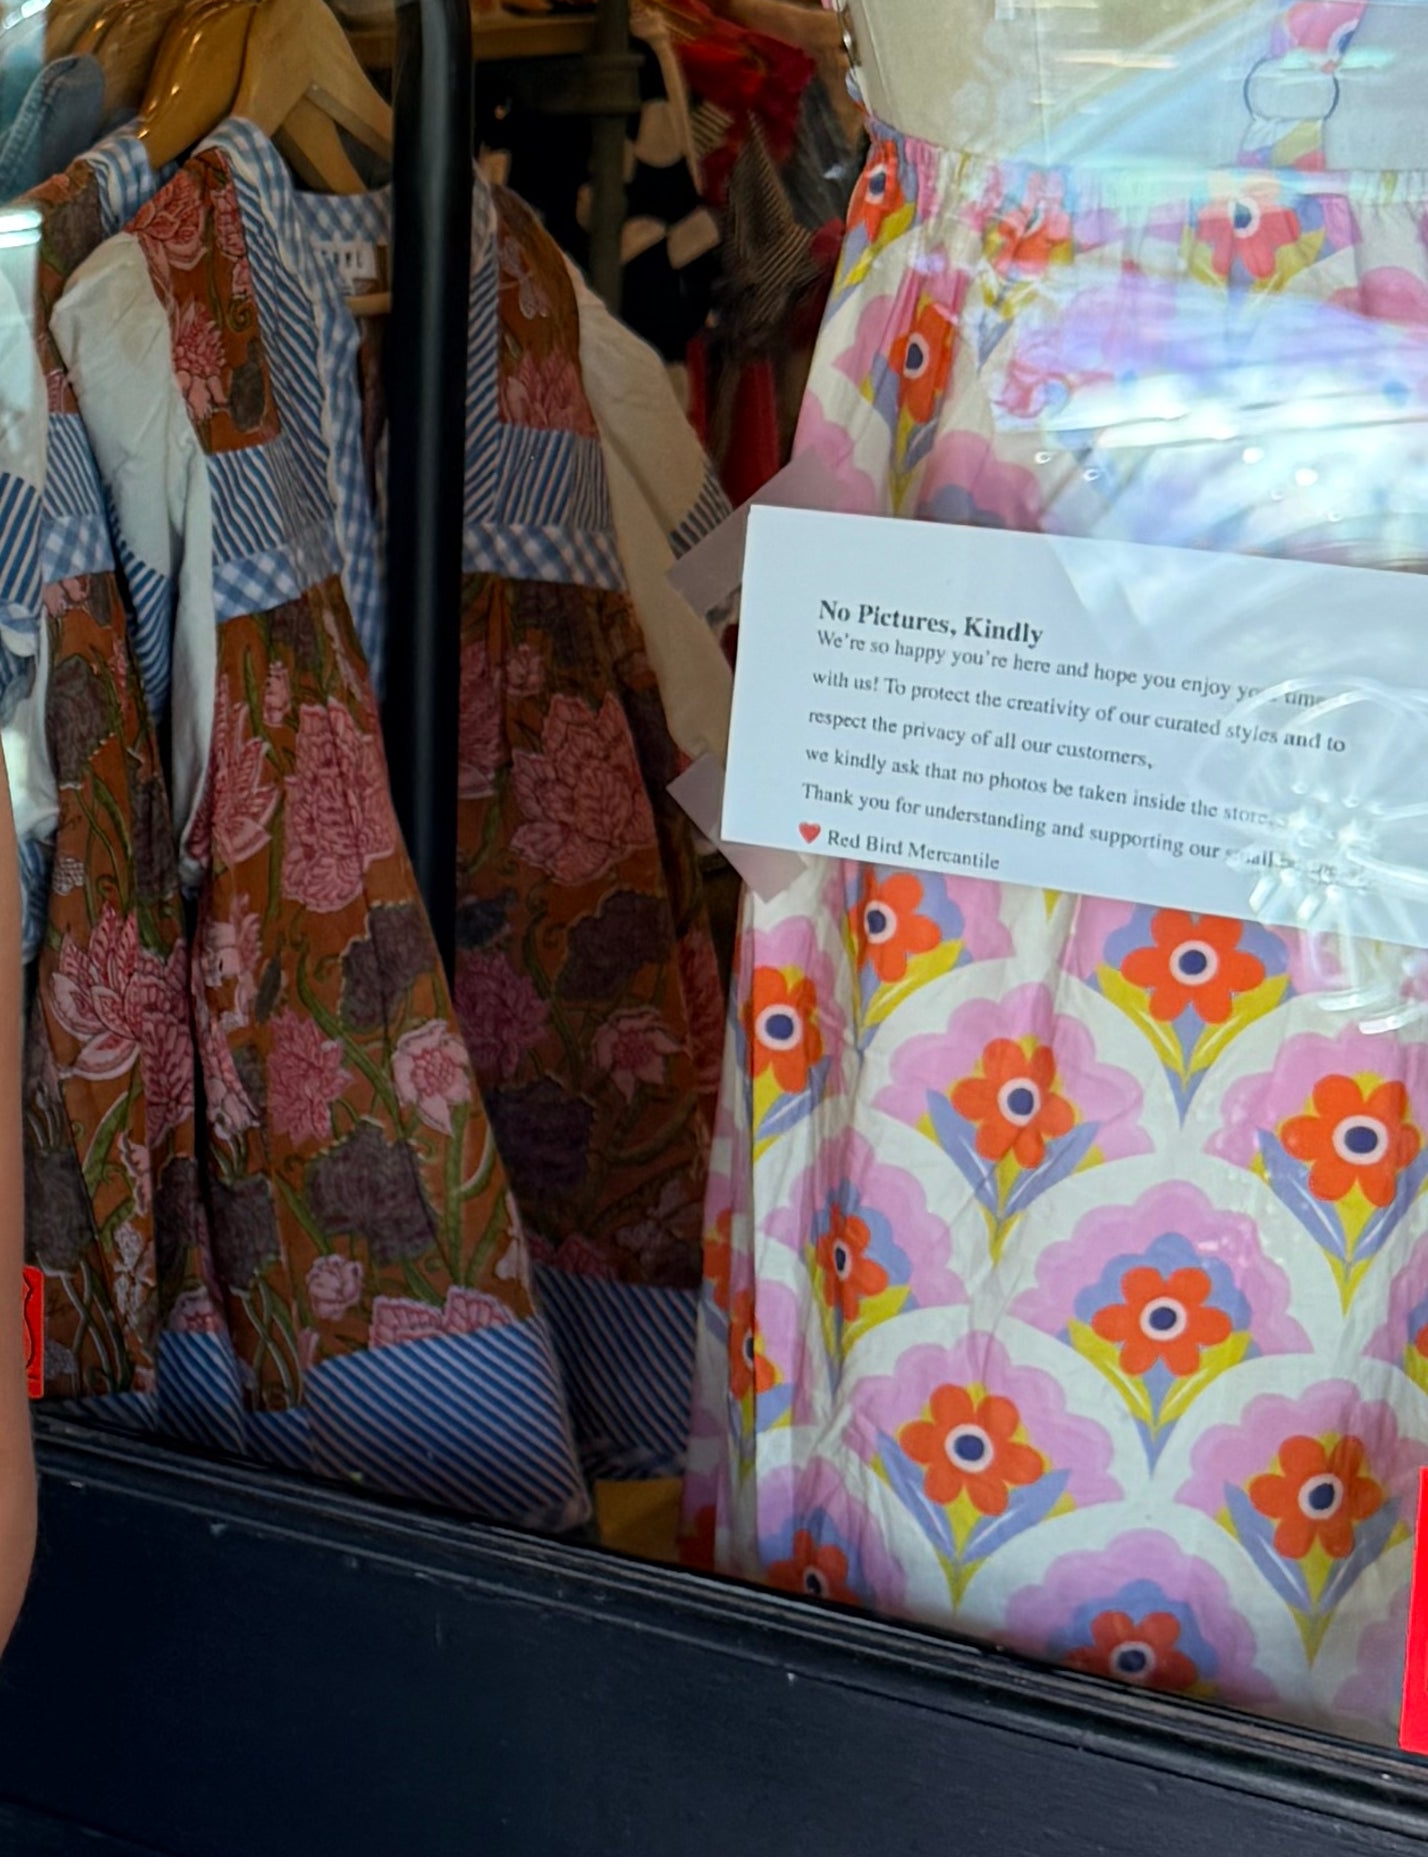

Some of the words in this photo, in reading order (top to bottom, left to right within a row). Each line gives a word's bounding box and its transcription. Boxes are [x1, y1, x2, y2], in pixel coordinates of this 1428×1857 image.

[819, 599, 851, 623] No
[858, 603, 958, 638] Pictures,
[963, 616, 1044, 649] Kindly
[817, 630, 866, 651] We're
[869, 641, 890, 654] so
[894, 640, 945, 665] happy
[951, 649, 1008, 669] you're
[1013, 654, 1052, 675] here
[1056, 661, 1089, 678] and
[1094, 663, 1138, 687] hope
[1140, 672, 1176, 690] you
[1181, 676, 1232, 700] enjoy
[808, 711, 867, 731] respect
[872, 713, 898, 735] the
[901, 721, 966, 748] privacy
[971, 730, 993, 747] of
[993, 732, 1017, 751] all
[1021, 741, 1052, 757] our
[1056, 743, 1153, 770] customers,
[812, 671, 849, 689] with
[853, 676, 880, 693] us!
[884, 677, 907, 696] To
[911, 684, 971, 705] protect
[975, 690, 1003, 709] the
[1006, 698, 1090, 722] creativity
[1095, 706, 1114, 722] of
[1119, 712, 1150, 727] our
[1154, 714, 1221, 736] curated
[1225, 722, 1279, 745] styles
[1284, 732, 1321, 750] and
[1326, 737, 1346, 753] to
[805, 749, 829, 763] we
[834, 748, 887, 775] kindly
[892, 759, 920, 777] ask
[924, 762, 958, 782] that
[962, 769, 985, 784] no
[988, 771, 1047, 794] photos
[1053, 778, 1074, 798] be
[1078, 784, 1128, 805] taken
[1132, 791, 1186, 813] inside
[1190, 799, 1218, 817] the
[802, 782, 854, 806] Thank
[858, 794, 890, 812] you
[895, 795, 921, 815] for
[924, 801, 1046, 837] understanding
[1051, 820, 1083, 839] and
[1089, 827, 1183, 858] supporting
[1189, 841, 1220, 859] our
[827, 829, 861, 850] Red
[865, 835, 903, 857] Bird
[908, 841, 1000, 871] Mercantile
